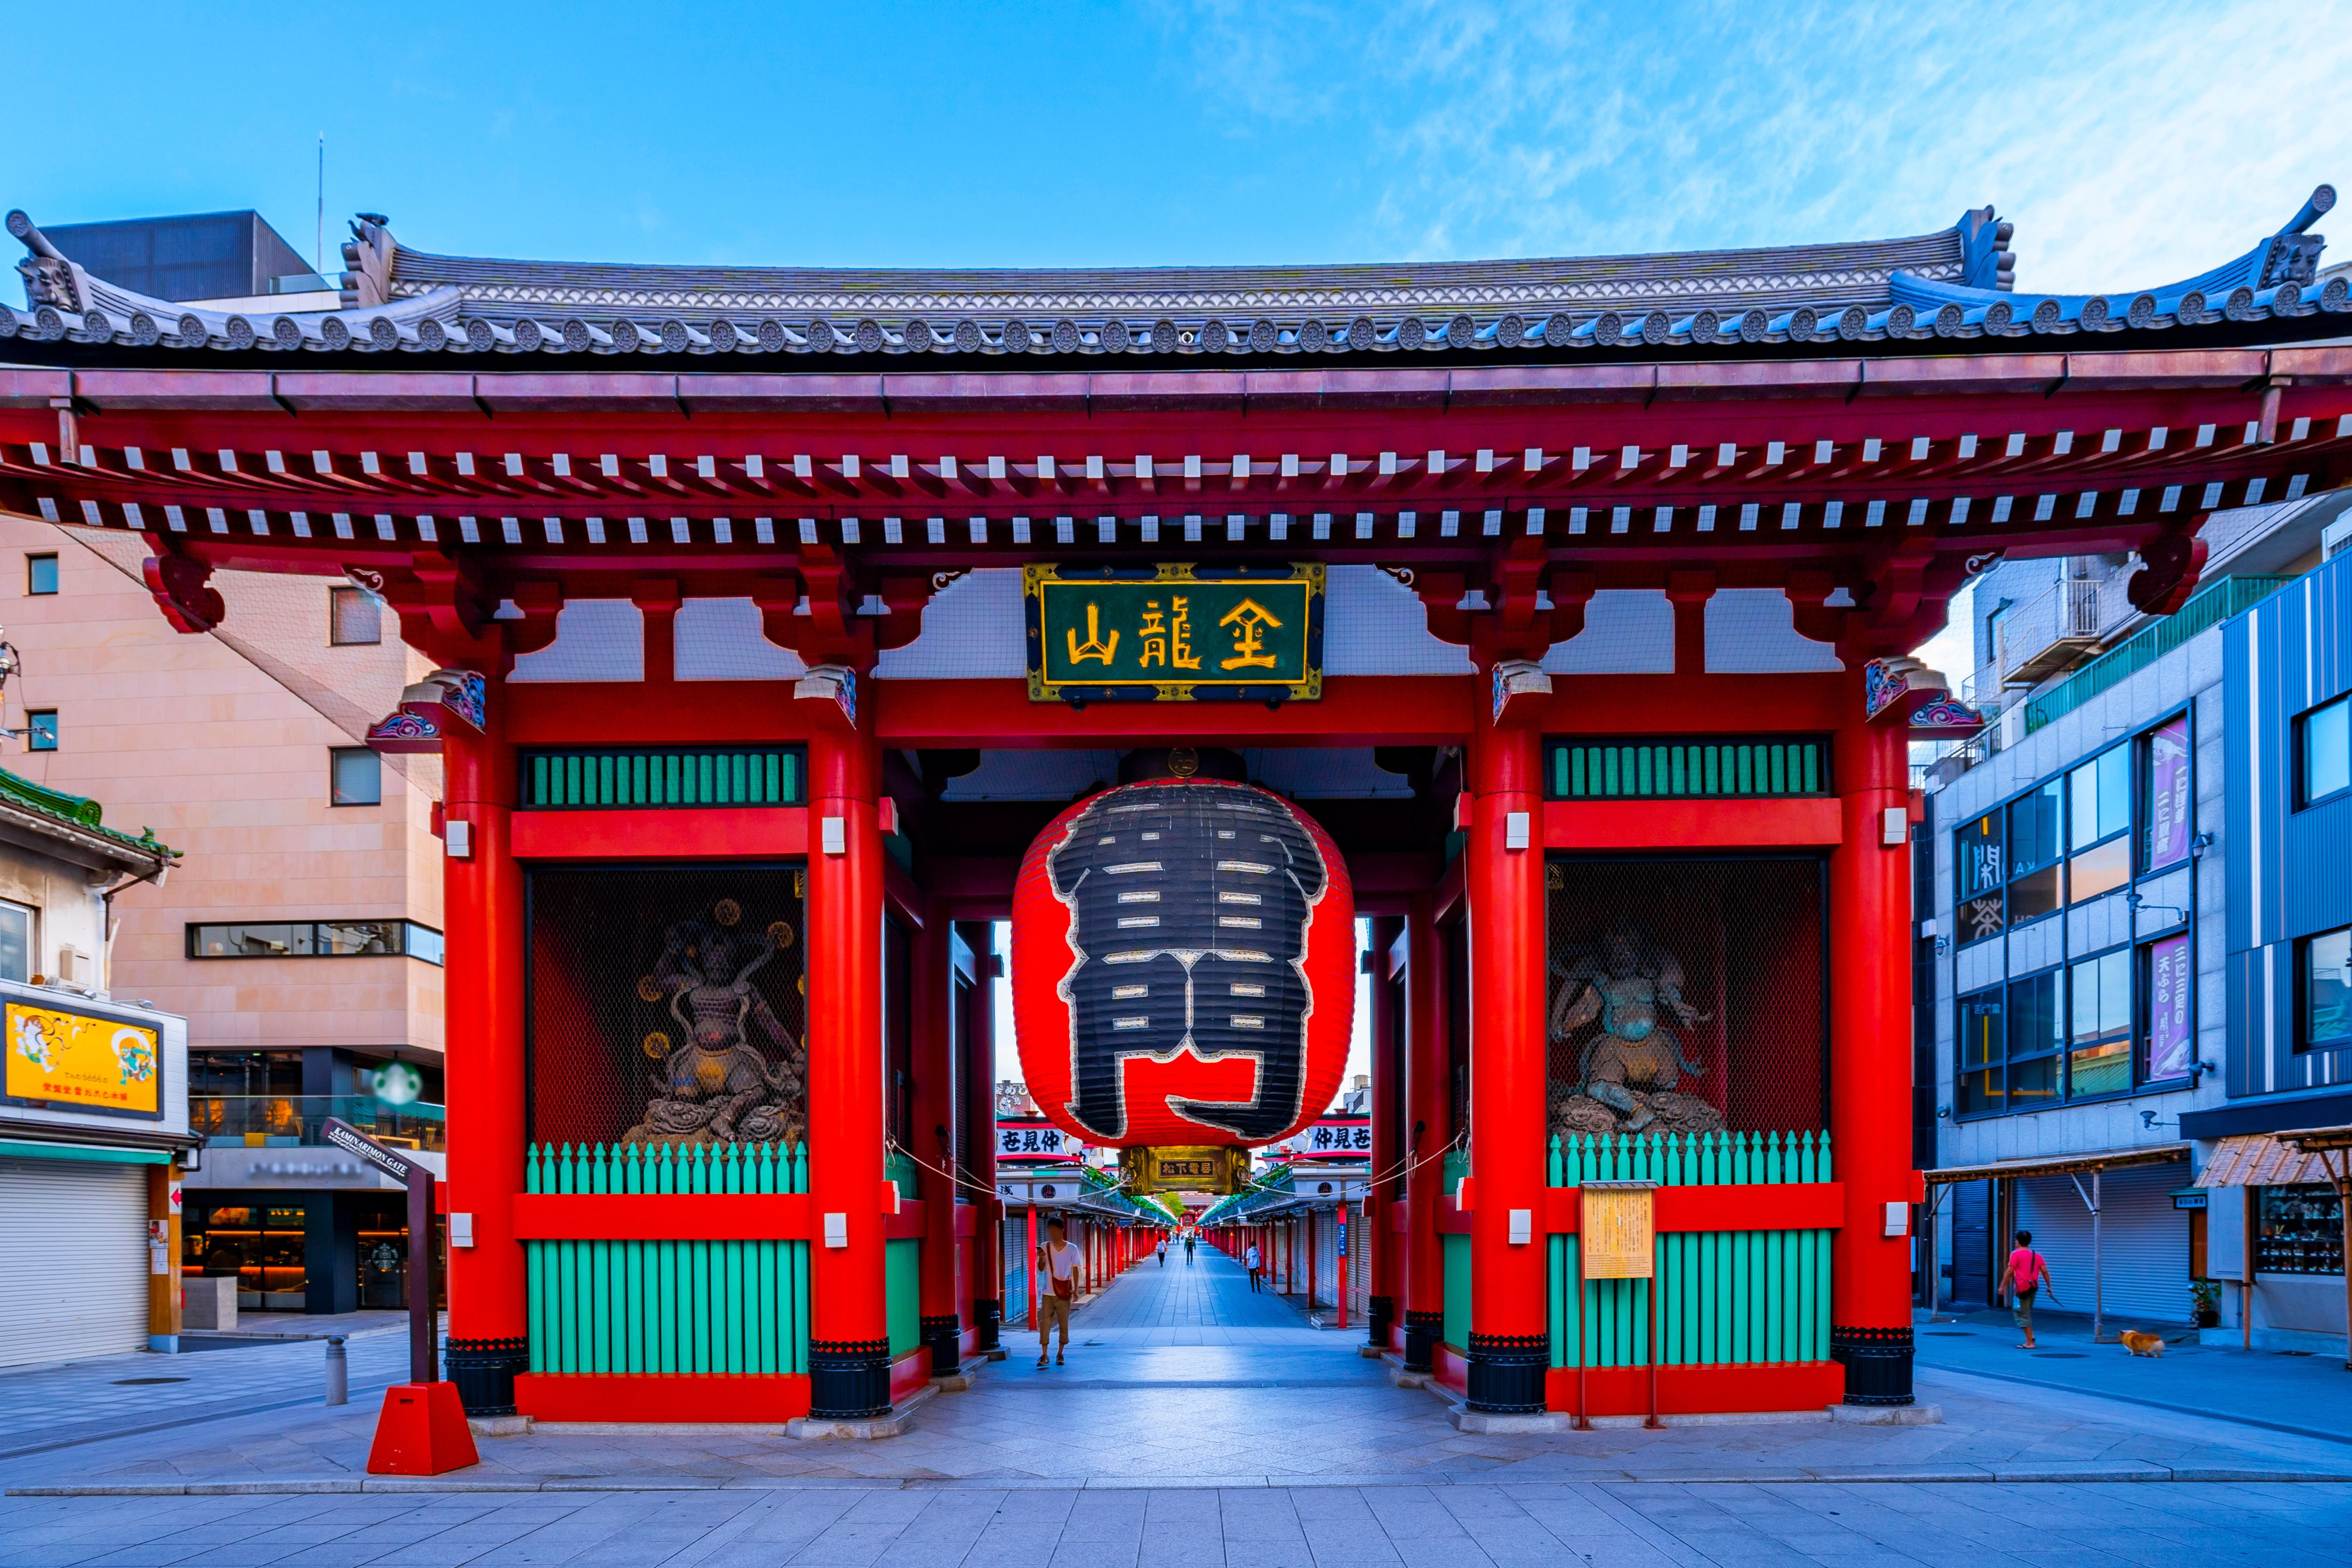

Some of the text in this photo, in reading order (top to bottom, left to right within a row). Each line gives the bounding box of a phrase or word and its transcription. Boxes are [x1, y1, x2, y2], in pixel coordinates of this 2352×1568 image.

[1046, 782, 1329, 1139] 雷門
[333, 1127, 388, 1161] KAMINARIMON
[387, 1158, 408, 1173] GATE
[1162, 1163, 1211, 1174] 松下電器
